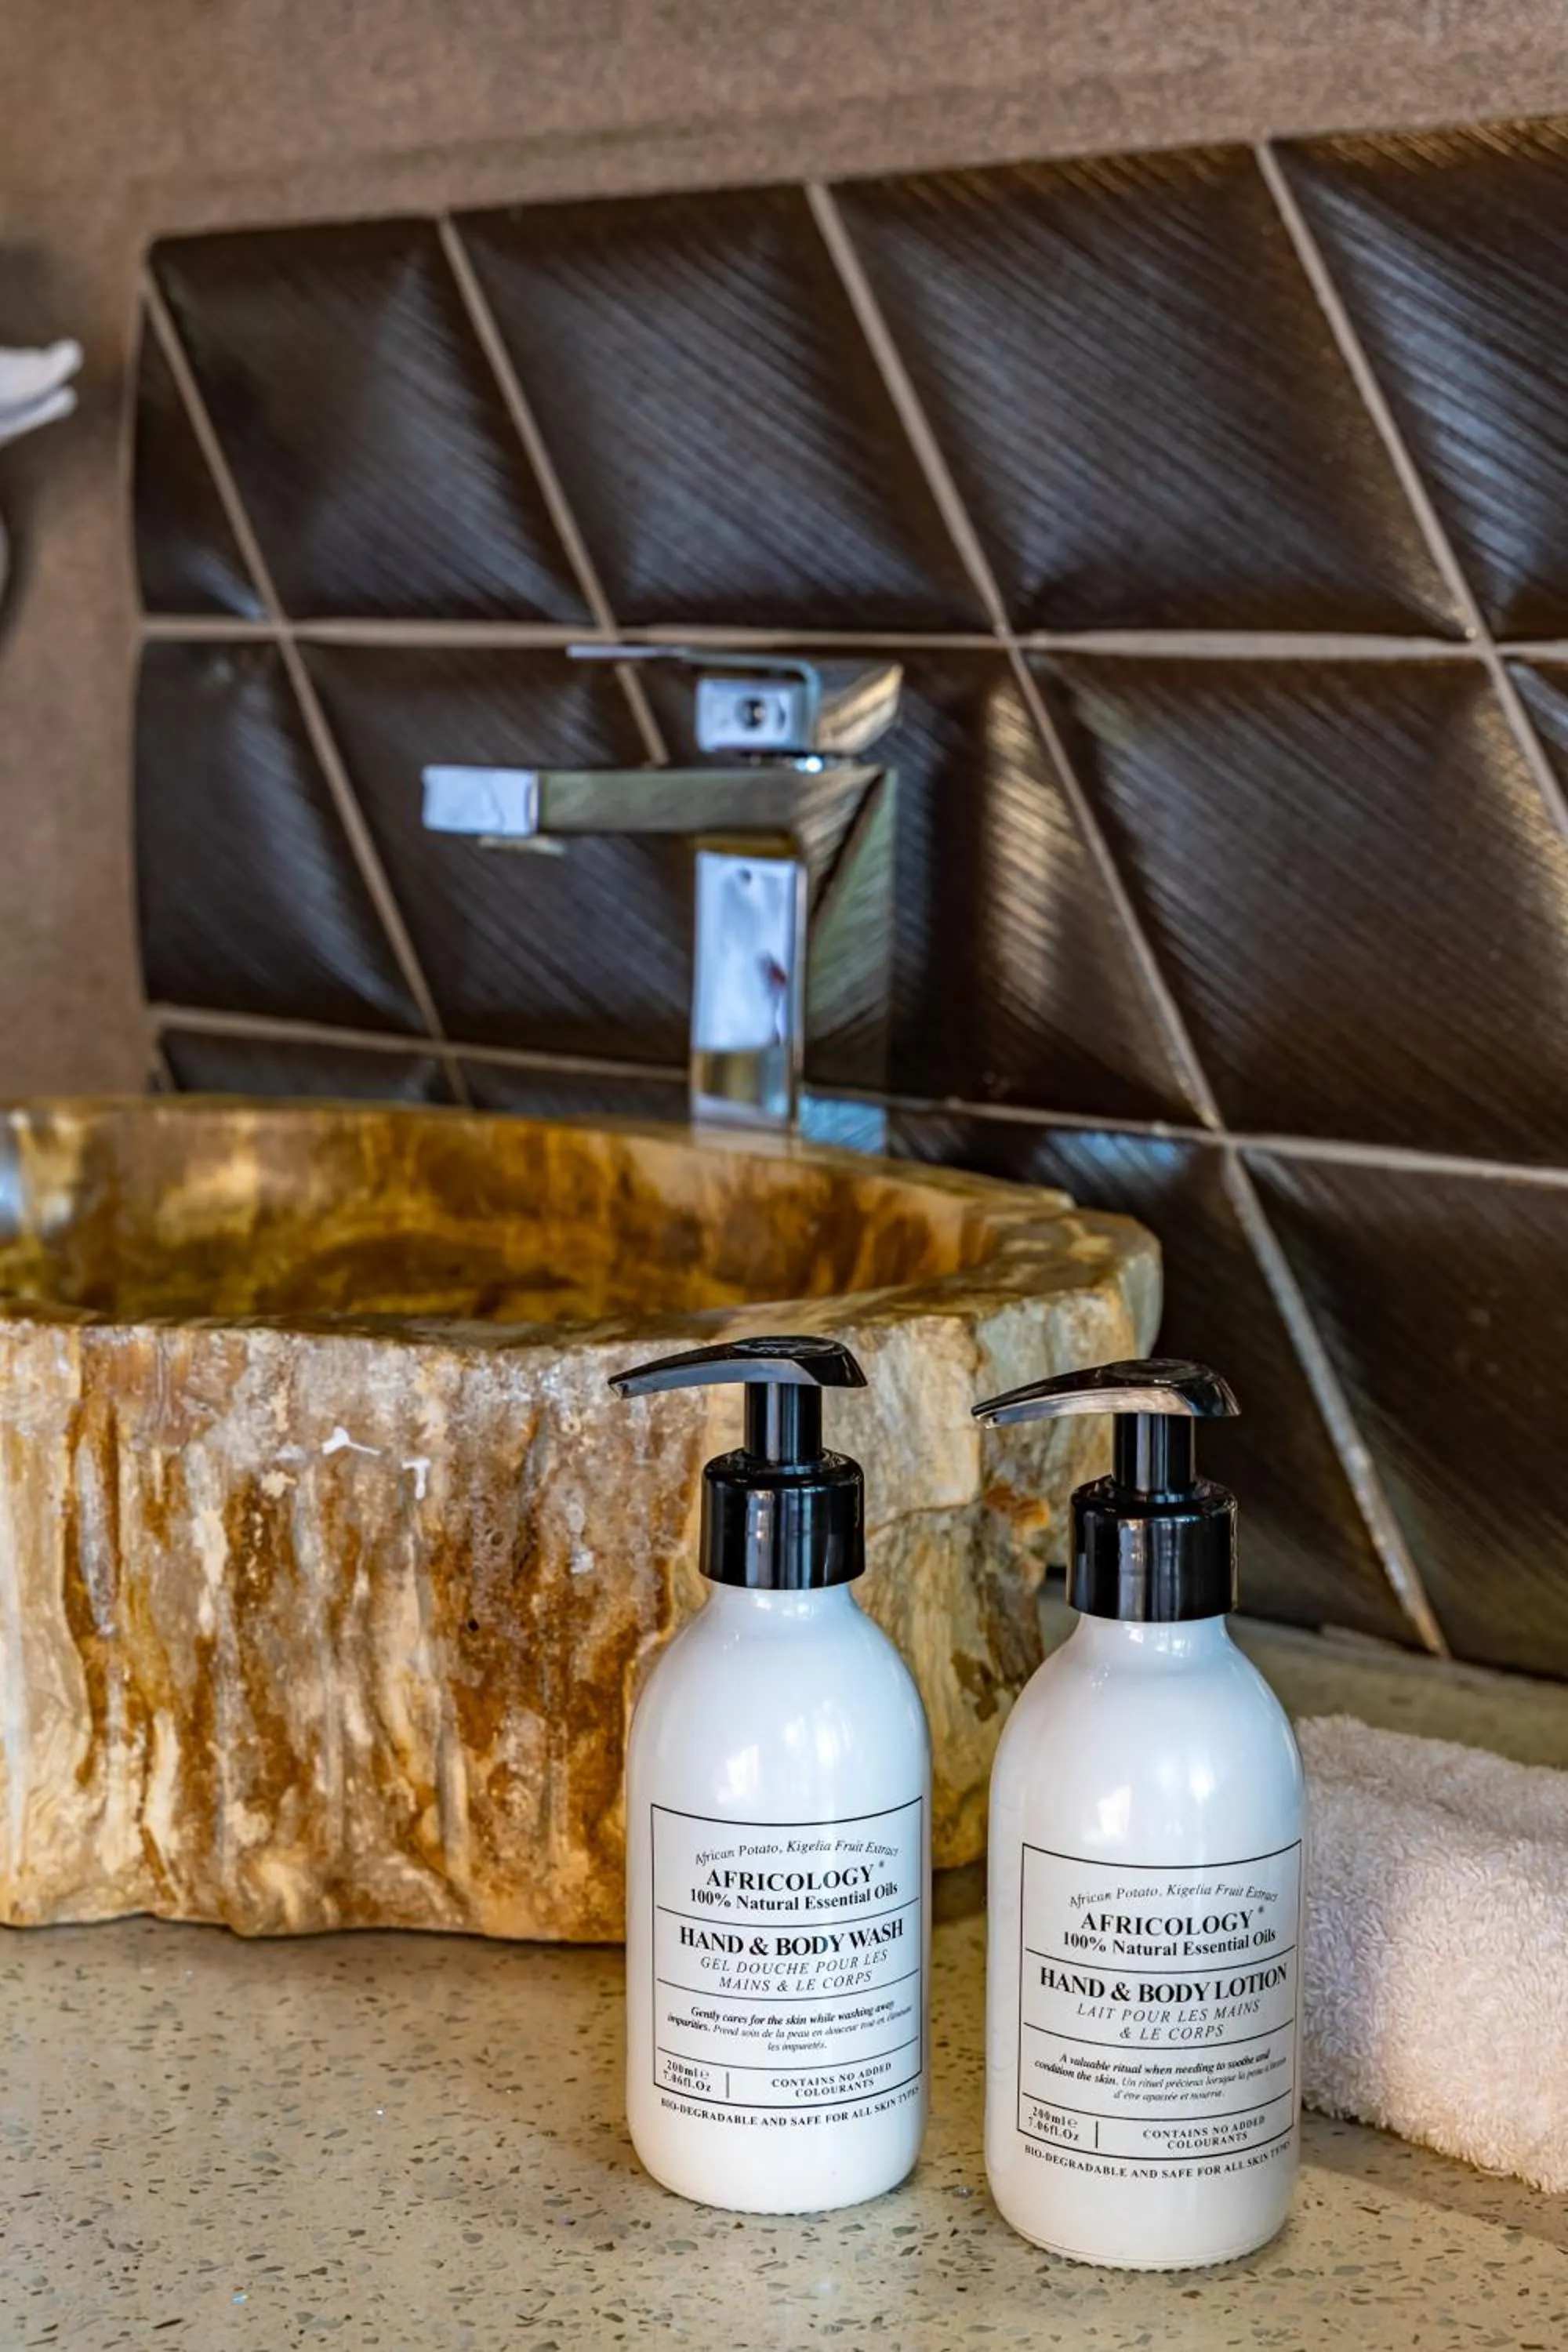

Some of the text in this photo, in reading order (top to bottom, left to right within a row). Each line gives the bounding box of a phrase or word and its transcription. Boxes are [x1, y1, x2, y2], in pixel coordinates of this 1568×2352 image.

[695, 1840, 898, 1865] African Potato, Kigelia Fruit Extract
[691, 1882, 898, 1911] 100% Natural Essential Oils
[1069, 1892, 1112, 1907] African
[1167, 1884, 1212, 1897] Kigelia
[1215, 1883, 1243, 1896] Fruit
[1246, 1886, 1278, 1903] Extract
[680, 1918, 904, 1956] HAND & BODY WASH
[1064, 1929, 1276, 1956] 100% Natural Essential Oils
[701, 1949, 887, 1974] GEL DOUCHE POUR LES
[719, 1971, 873, 1992] MAINS & LE CORPS
[1040, 1962, 1288, 2003] HAND & BODY LOTION
[691, 2006, 720, 2022] Gently
[722, 2013, 747, 2024] cares
[748, 2014, 764, 2026] for
[767, 2015, 783, 2024] the
[786, 2014, 807, 2025] skin
[810, 2013, 835, 2024] while
[1077, 1999, 1261, 2023] LAIT POUR LES MAINS
[762, 2029, 773, 2038] de
[775, 2029, 785, 2038] la
[1120, 2024, 1225, 2040] & LE CORPS
[771, 2062, 891, 2088] CONTAINS NO ADDED
[1034, 2059, 1075, 2078] condition
[1076, 2071, 1092, 2082] the
[1094, 2074, 1120, 2086] skin.
[1059, 2053, 1068, 2063] A
[1070, 2056, 1111, 2071] valuable
[1112, 2063, 1142, 2074] ritual
[1145, 2064, 1172, 2074] when
[1175, 2062, 1214, 2074] needing
[1216, 2061, 1226, 2071] to
[796, 2078, 874, 2097] COLOURANTS
[661, 2097, 757, 2125] BIO-DEGRADABLE
[760, 2117, 786, 2126] AND
[790, 2115, 822, 2125] SAFE
[826, 2112, 848, 2123] FOR
[852, 2107, 873, 2118] ALL
[874, 2096, 896, 2112] SKIN
[1142, 2115, 1265, 2140] CONTAINS NO ADDED
[1167, 2132, 1247, 2150] COLOURANTS
[1025, 2144, 1127, 2177] BIO-DEGRADABLE
[1132, 2169, 1158, 2178] AND
[1161, 2169, 1192, 2178] SAFE
[1197, 2165, 1221, 2176] FOR
[1225, 2160, 1244, 2172] ALL
